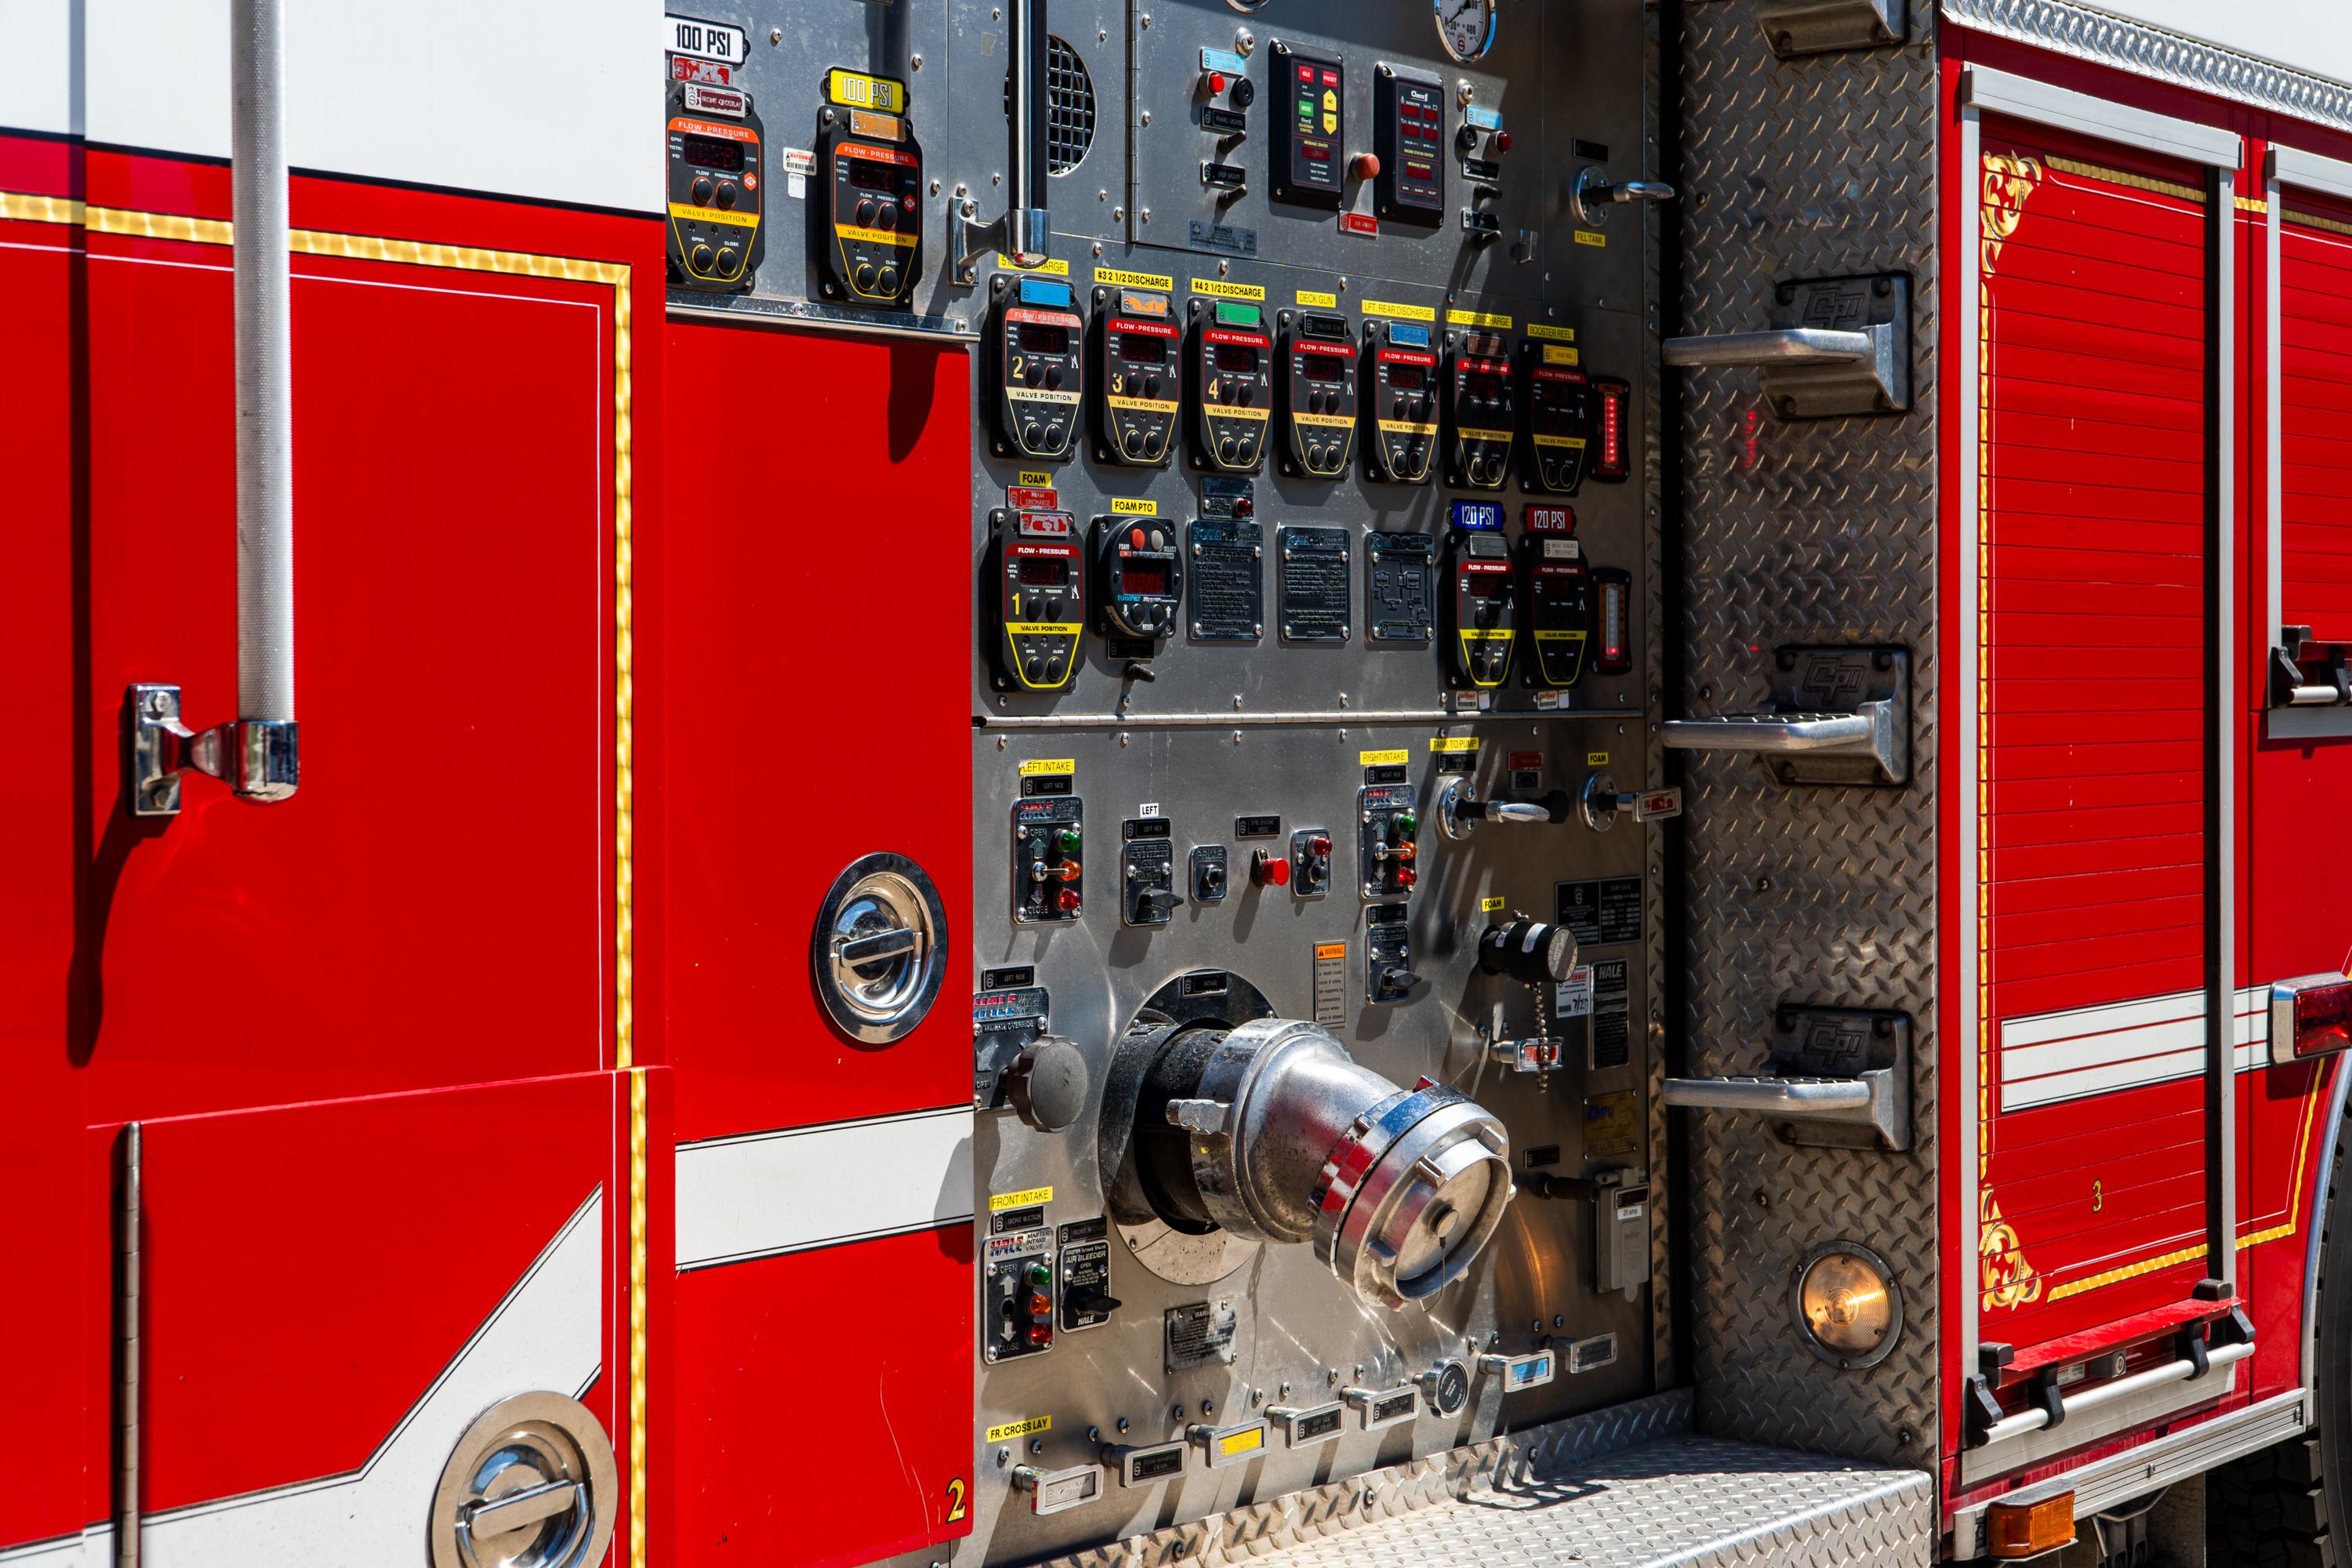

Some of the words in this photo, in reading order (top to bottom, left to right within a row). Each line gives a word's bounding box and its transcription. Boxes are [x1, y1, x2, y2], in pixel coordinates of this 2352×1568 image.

[677, 23, 702, 51] 100
[707, 28, 731, 56] PSI
[843, 77, 866, 103] 100
[870, 82, 892, 107] PSI
[710, 212, 747, 223] POSITION
[873, 233, 906, 243] POSITION
[1577, 232, 1588, 243] FILL
[1588, 234, 1603, 245] TANK
[1108, 272, 1112, 281] 2
[1115, 273, 1127, 282] 1/2
[1127, 274, 1169, 287] DISCHARGE
[1195, 281, 1203, 290] #4
[1204, 282, 1209, 291] 2
[1211, 283, 1221, 293] 1/2
[1222, 285, 1261, 297] DISCHARGE
[1299, 293, 1317, 303] DECK
[1318, 295, 1333, 305] GUN
[1379, 303, 1395, 314] REAR
[1397, 306, 1432, 318] DISCHARGE
[1459, 313, 1475, 323] REAR
[1475, 314, 1509, 326] DISCHARGE
[1530, 326, 1556, 337] BOOSTER
[1557, 328, 1572, 339] REEL
[1012, 356, 1024, 379] 2
[1112, 372, 1123, 393] 3
[1208, 378, 1218, 400] 4
[1022, 474, 1046, 484] FOAM
[1115, 501, 1137, 511] FOAM
[1138, 503, 1152, 512] PTO
[1461, 506, 1477, 525] 120
[1479, 506, 1494, 525] PSI
[1534, 510, 1548, 528] 120
[1552, 511, 1565, 529] PSI
[1012, 593, 1019, 615] 1
[1433, 740, 1448, 749] TANK
[1459, 739, 1476, 748] PUMP
[1363, 753, 1382, 762] RIGHT
[1383, 752, 1405, 760] INTAKE
[1590, 754, 1606, 763] FOAM
[1043, 761, 1071, 771] INTAKE
[1142, 806, 1157, 815] LEFT
[1029, 828, 1047, 837] OPEN
[1197, 849, 1224, 861] PRIME
[1484, 898, 1502, 909] FOAM
[1028, 906, 1048, 915] CLOSE
[1324, 946, 1344, 956] WARNING
[1599, 964, 1623, 979] HALE
[1008, 1021, 1034, 1030] OVERRIDE
[976, 1080, 991, 1091] OPEN
[992, 1194, 1019, 1207] FRONT
[1021, 1189, 1049, 1202] INTAKE
[2091, 1178, 2103, 1214] 3
[1022, 1214, 1042, 1222] SUCTION
[1028, 1230, 1051, 1239] MASTER
[1066, 1255, 1076, 1264] AIR
[1077, 1250, 1106, 1261] BLEEDER
[1000, 1264, 1017, 1273] OPEN
[1077, 1315, 1094, 1326] HALE
[998, 1341, 1019, 1352] CLOSE
[990, 1428, 1002, 1439] FR.
[1004, 1421, 1030, 1436] CROSS
[1031, 1417, 1047, 1430] LAY
[946, 1478, 967, 1523] 2
